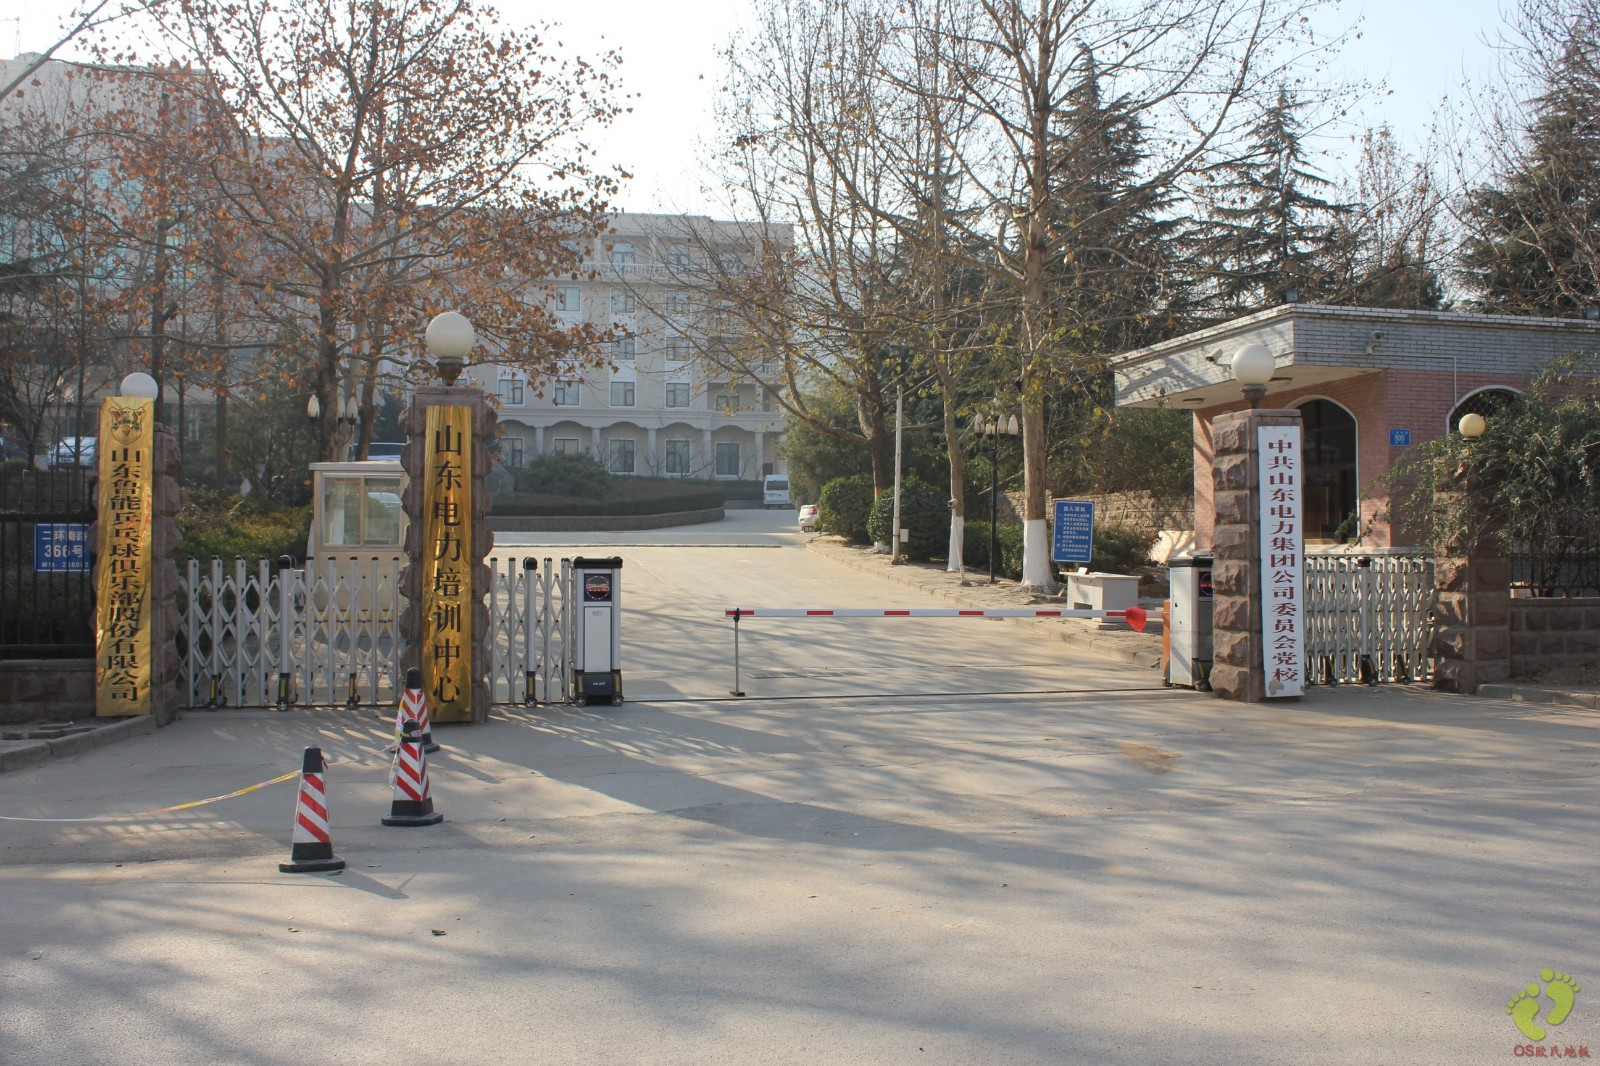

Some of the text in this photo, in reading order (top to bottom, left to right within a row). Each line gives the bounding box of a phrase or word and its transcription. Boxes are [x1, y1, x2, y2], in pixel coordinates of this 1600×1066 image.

[108, 447, 141, 701] 山东鲁能乒乓球俱乐部股份有限公司
[433, 425, 463, 705] 山东电力培训中心
[1268, 439, 1299, 683] 中共山东电力集团公司委员会党校
